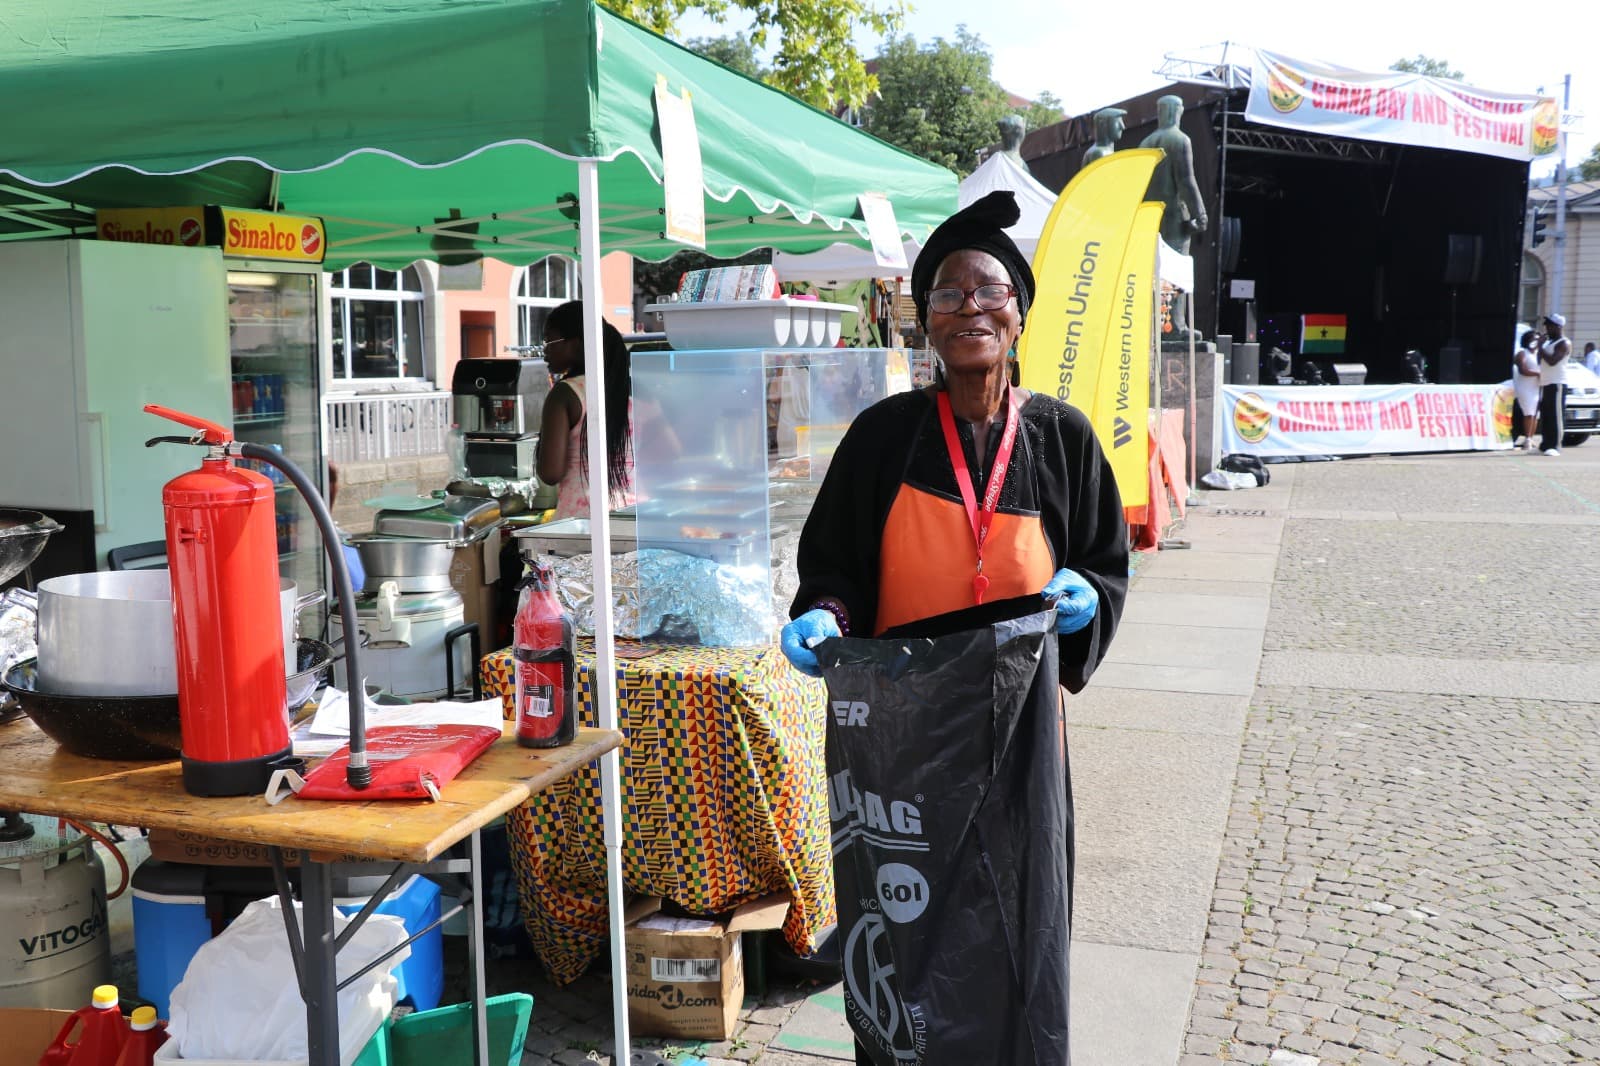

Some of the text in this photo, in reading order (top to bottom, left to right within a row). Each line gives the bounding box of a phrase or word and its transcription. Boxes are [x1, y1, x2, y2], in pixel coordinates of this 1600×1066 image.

[1376, 88, 1406, 120] DAY
[1412, 92, 1448, 125] AND
[1454, 112, 1524, 146] FESTIVAL
[102, 221, 174, 245] Sinalco
[228, 217, 296, 251] Sinalco
[1057, 240, 1101, 401] estern Union
[1115, 273, 1137, 411] Western Union
[1342, 400, 1374, 431] DAY
[1379, 400, 1413, 430] AND
[1415, 392, 1486, 416] HIGHLIFE
[1418, 415, 1488, 438] FESTIVAL
